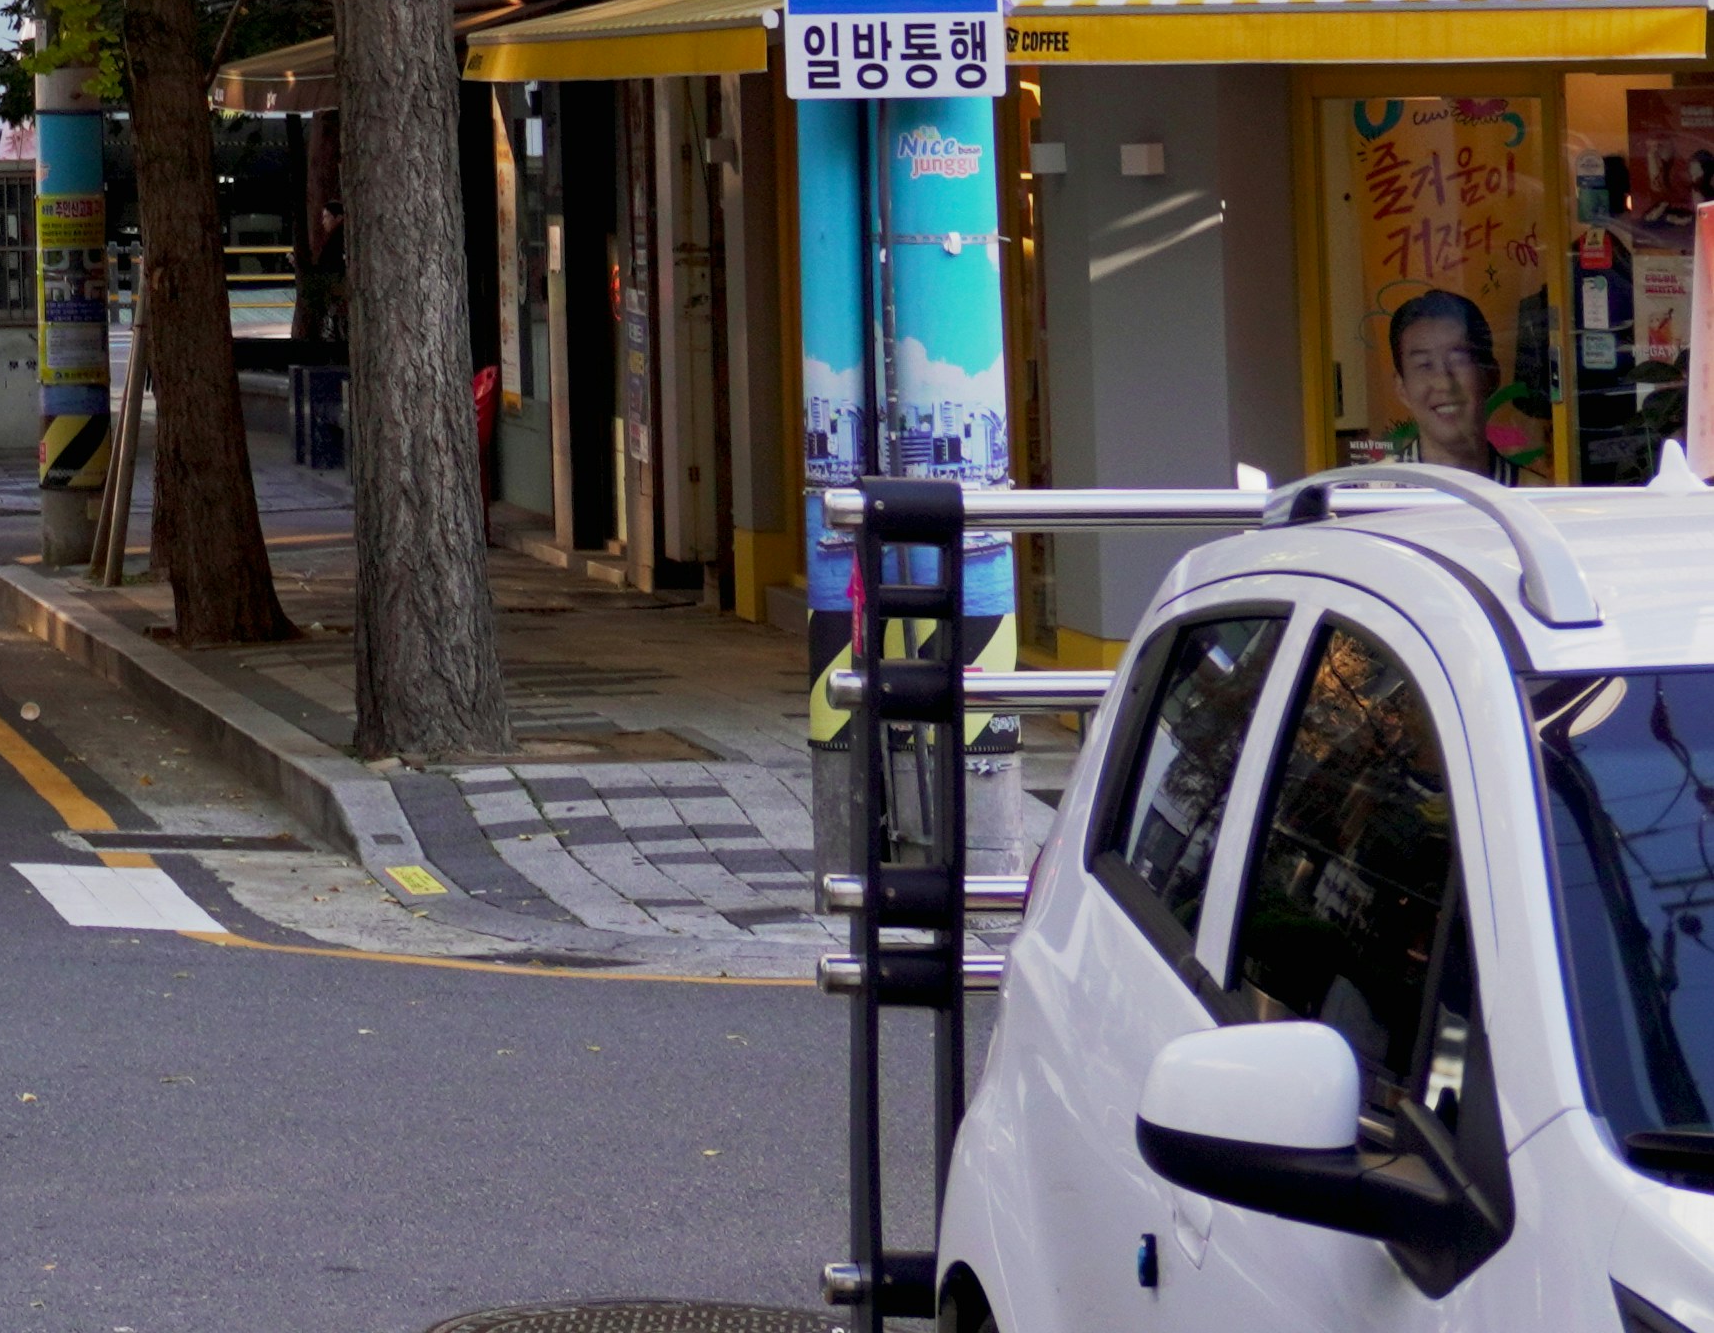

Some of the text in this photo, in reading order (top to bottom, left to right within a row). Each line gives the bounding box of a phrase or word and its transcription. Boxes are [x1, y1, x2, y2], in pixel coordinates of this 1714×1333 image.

[804, 21, 987, 90] 일방통행
[1022, 32, 1069, 52] COFFEE
[899, 134, 957, 157] Nice
[912, 155, 979, 176] junggu
[1366, 142, 1516, 221] 즐거움이
[1383, 216, 1503, 280] 커진다
